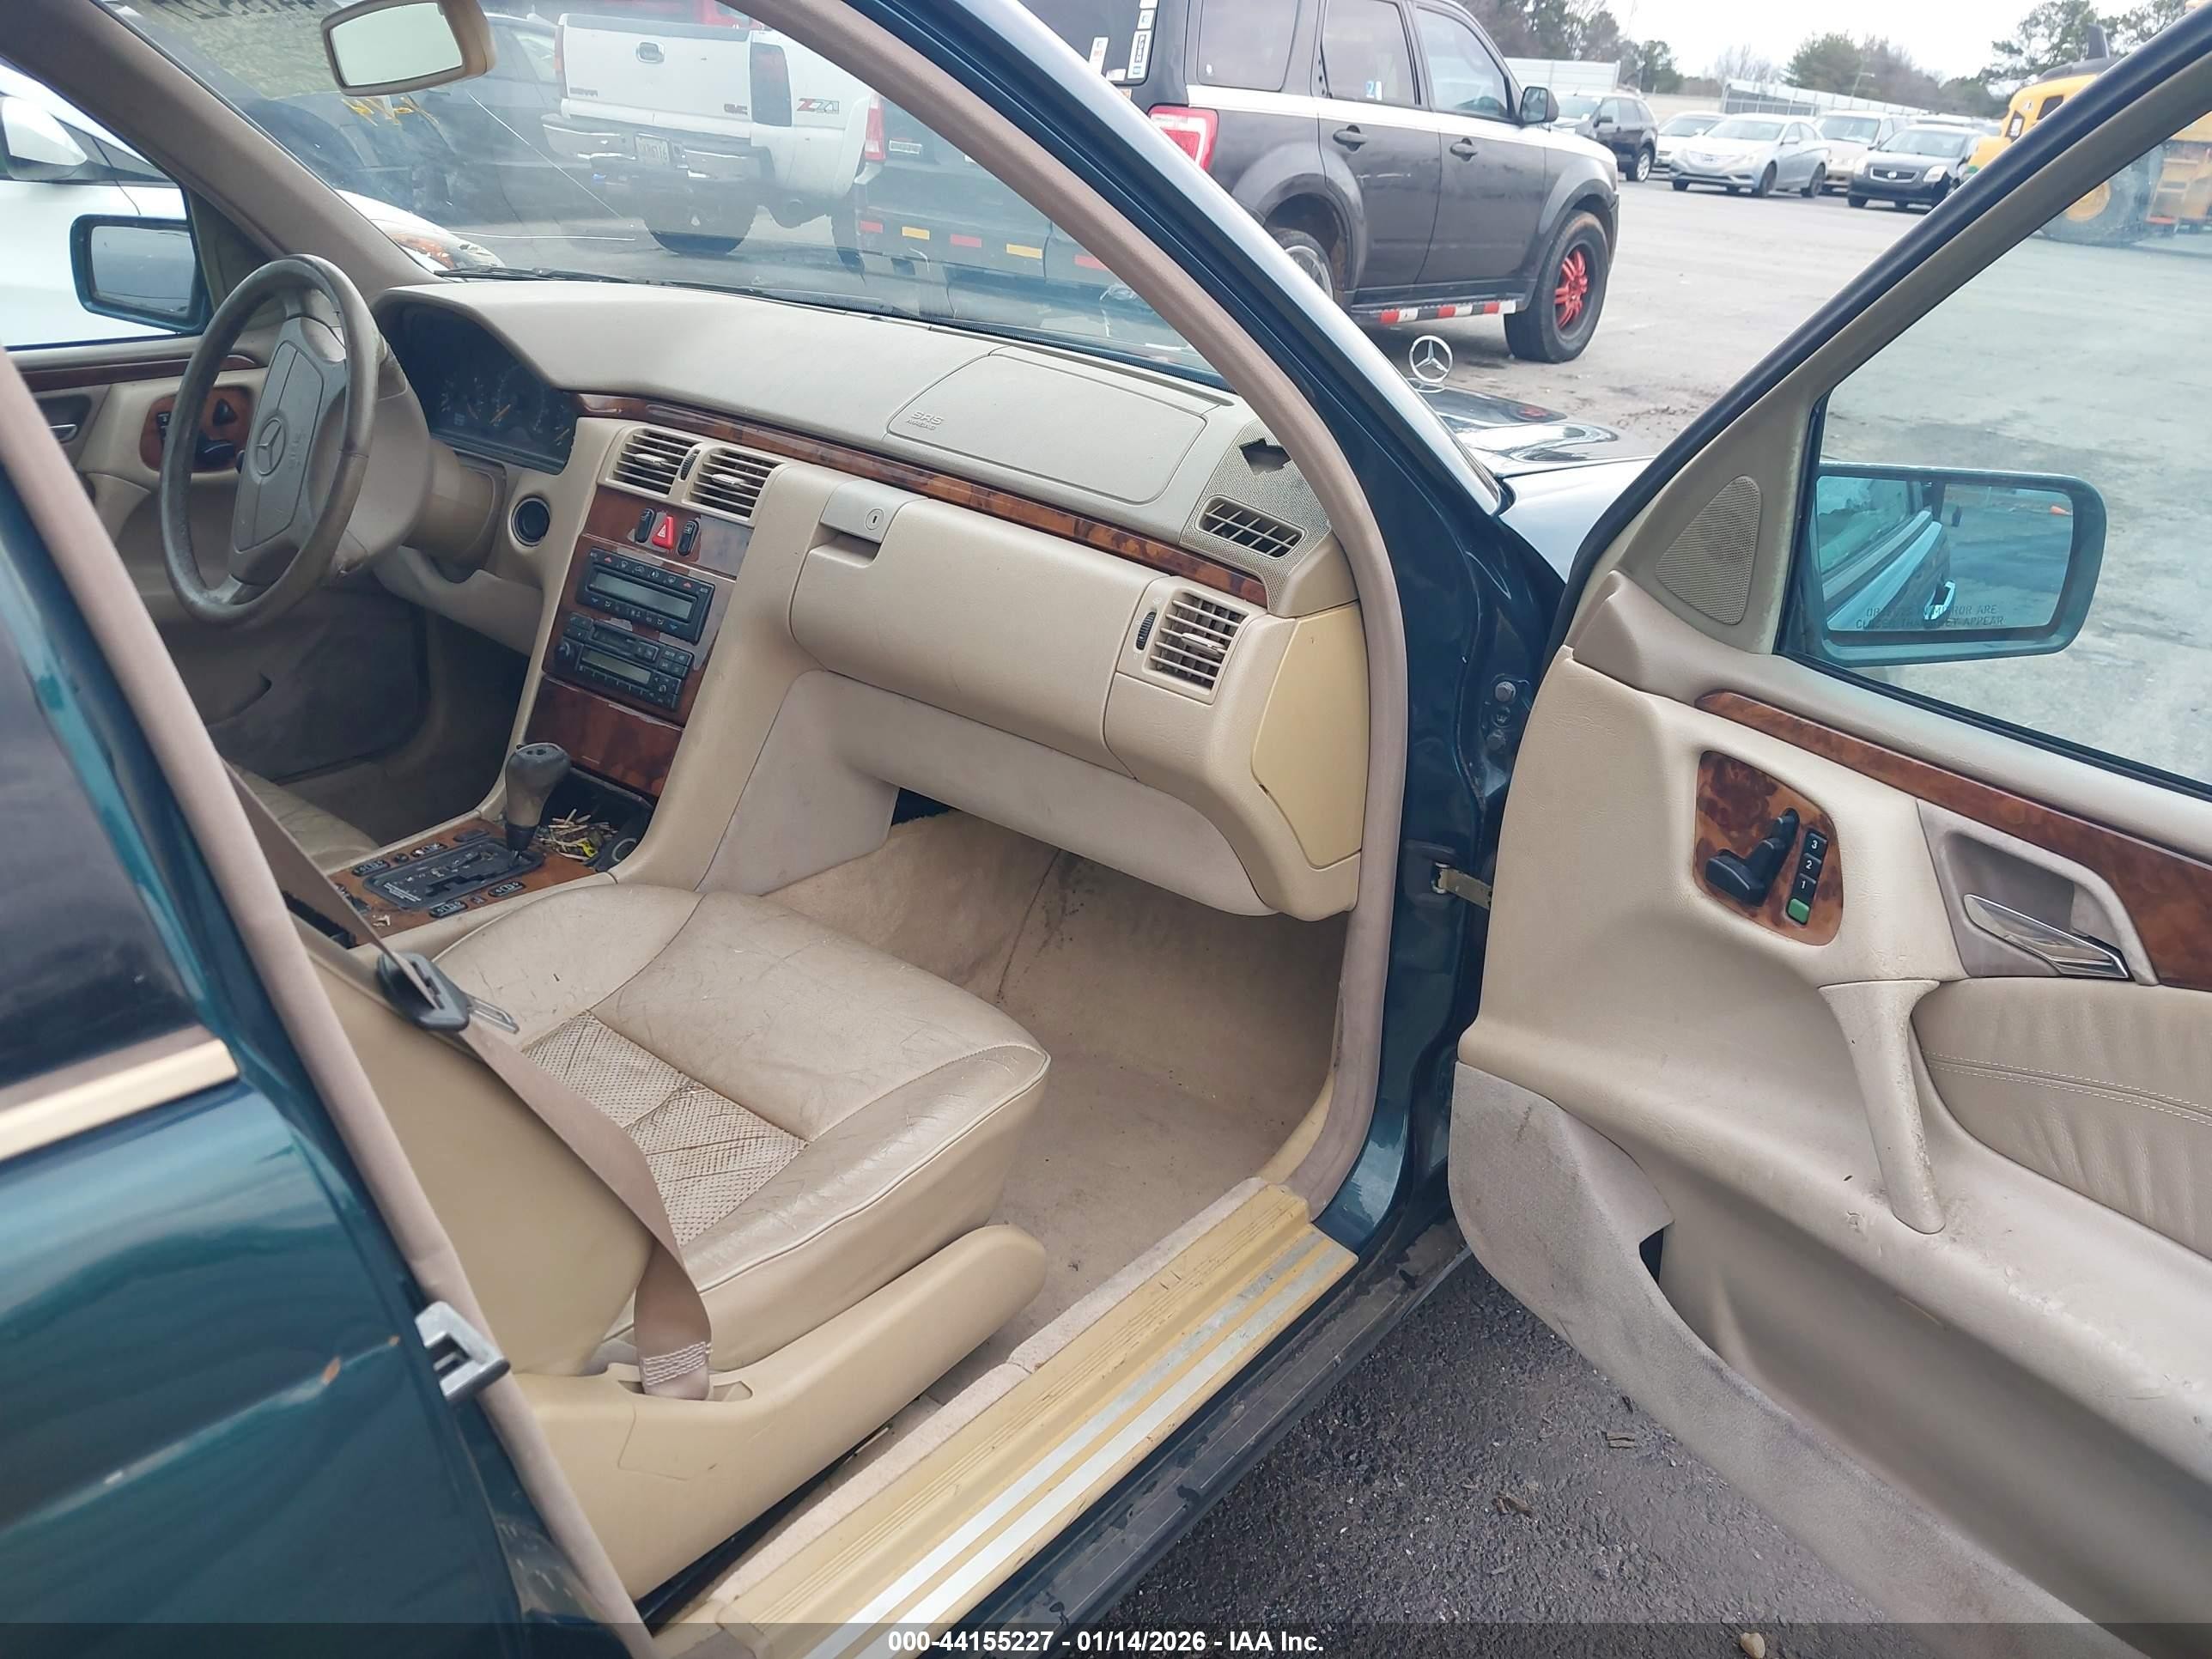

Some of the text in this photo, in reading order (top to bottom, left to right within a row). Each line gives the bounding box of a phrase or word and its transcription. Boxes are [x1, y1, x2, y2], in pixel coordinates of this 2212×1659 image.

[797, 98, 840, 113] Z71
[911, 410, 944, 425] SRS
[1977, 604, 1998, 615] ARE
[1964, 616, 2003, 627] APPEAR
[1811, 840, 1818, 849] 3
[1805, 860, 1813, 870] 2
[1801, 880, 1806, 889] 1
